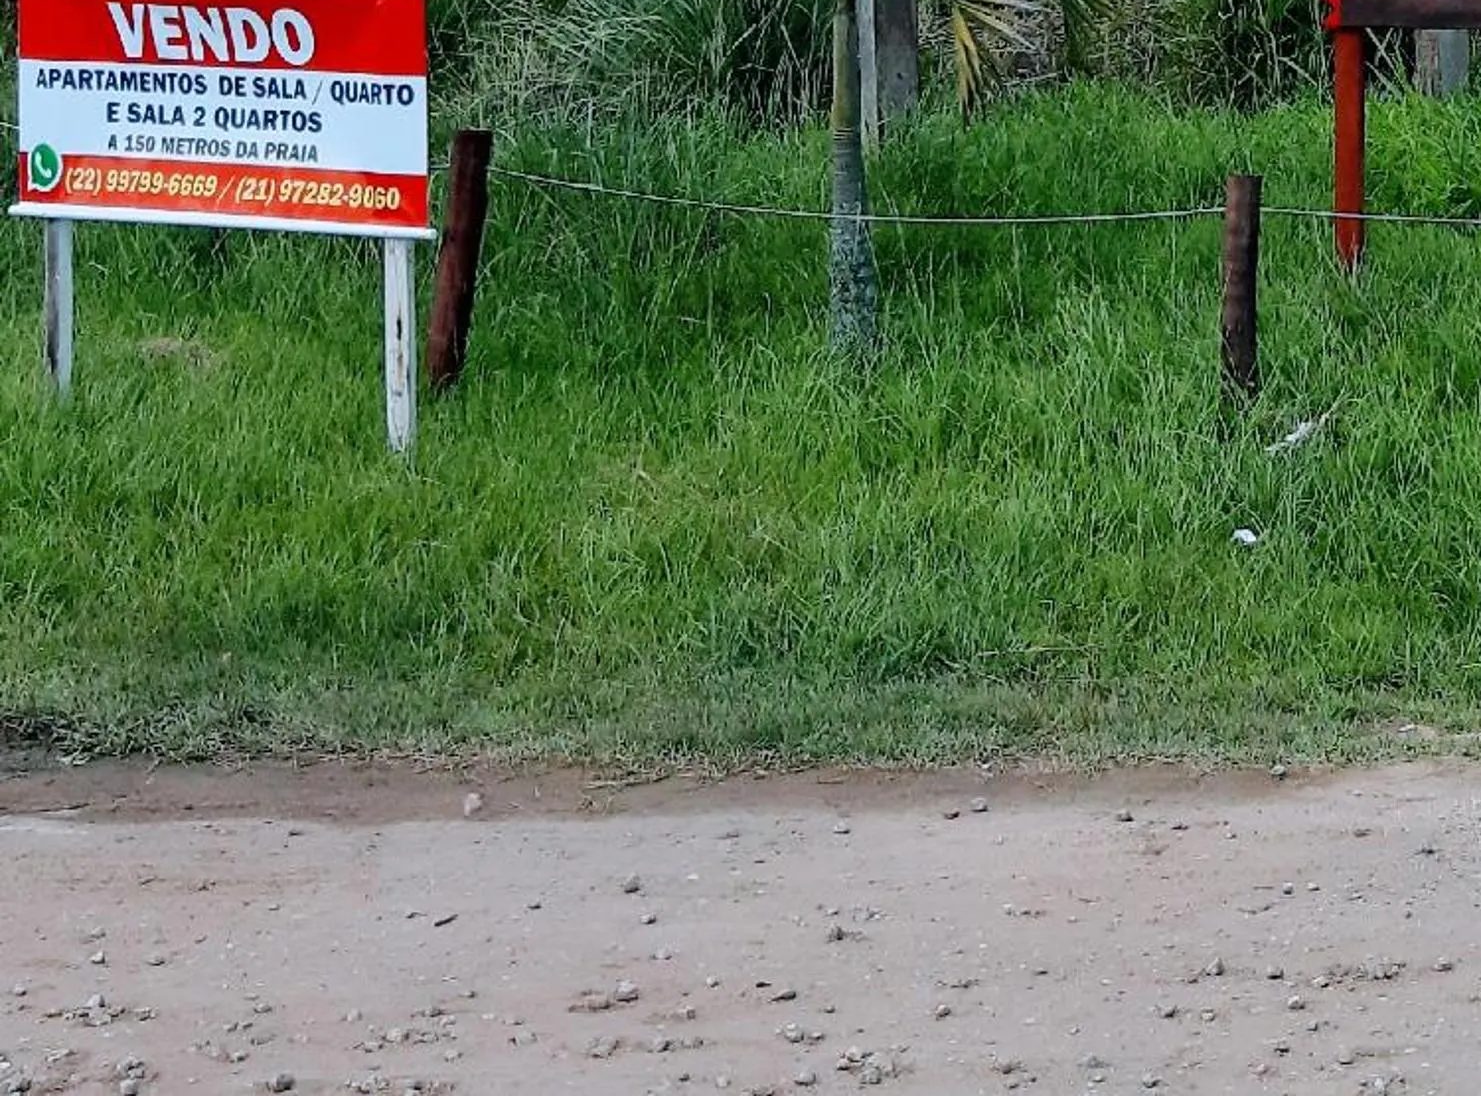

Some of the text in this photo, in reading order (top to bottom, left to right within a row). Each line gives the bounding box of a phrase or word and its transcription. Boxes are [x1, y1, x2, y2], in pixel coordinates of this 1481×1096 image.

[106, 1, 315, 66] VENDO
[36, 67, 208, 96] APARTAMENTOS
[219, 74, 246, 97] DE
[252, 76, 307, 100] SALA
[330, 80, 415, 106] QUARTO
[106, 102, 323, 133] E SALA 2 QUARTOS
[107, 133, 319, 163] A 150 METROS DA PRAIA
[65, 166, 102, 196] (22)
[235, 174, 276, 207] (21)
